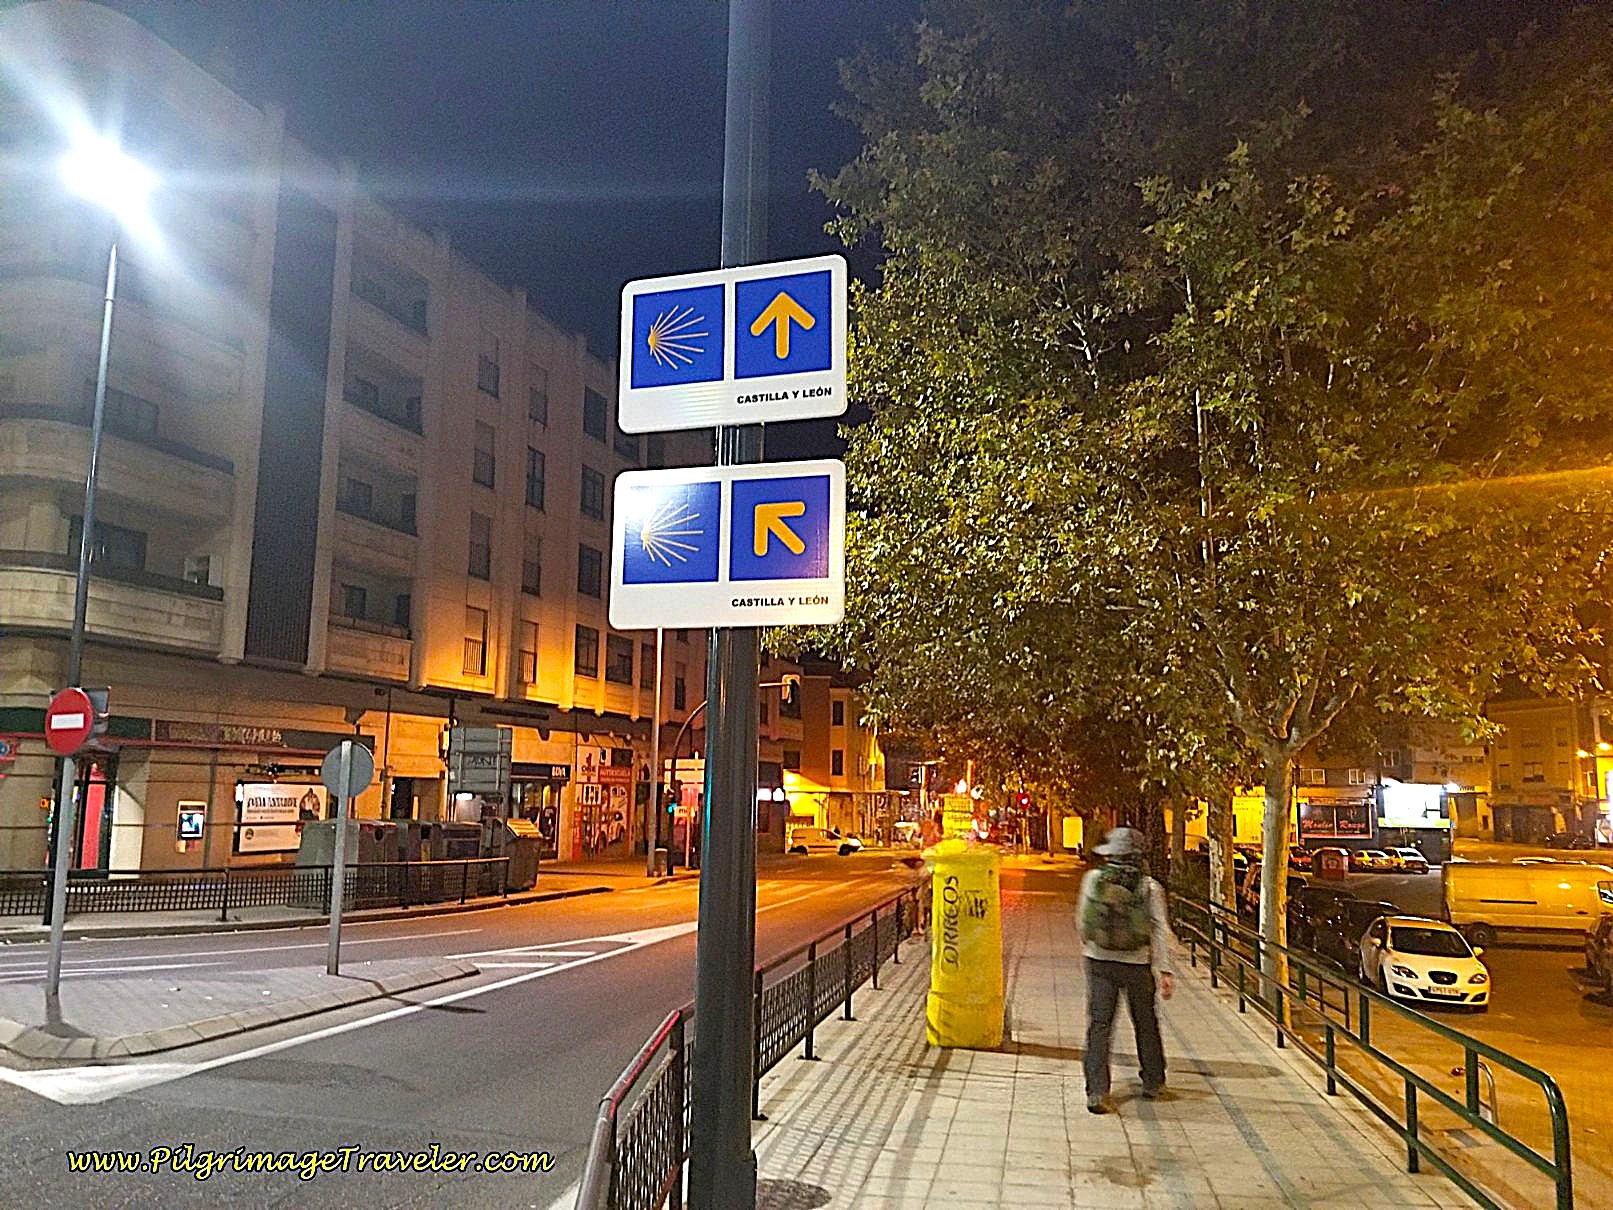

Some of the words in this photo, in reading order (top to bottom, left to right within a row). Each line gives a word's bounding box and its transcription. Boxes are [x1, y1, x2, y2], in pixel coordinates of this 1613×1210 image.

[736, 391, 789, 404] CASTILLA
[791, 390, 800, 399] Y
[802, 386, 832, 398] LEÓN
[731, 597, 785, 607] CASTILLA
[788, 597, 796, 606] Y
[799, 594, 829, 606] LEÓN
